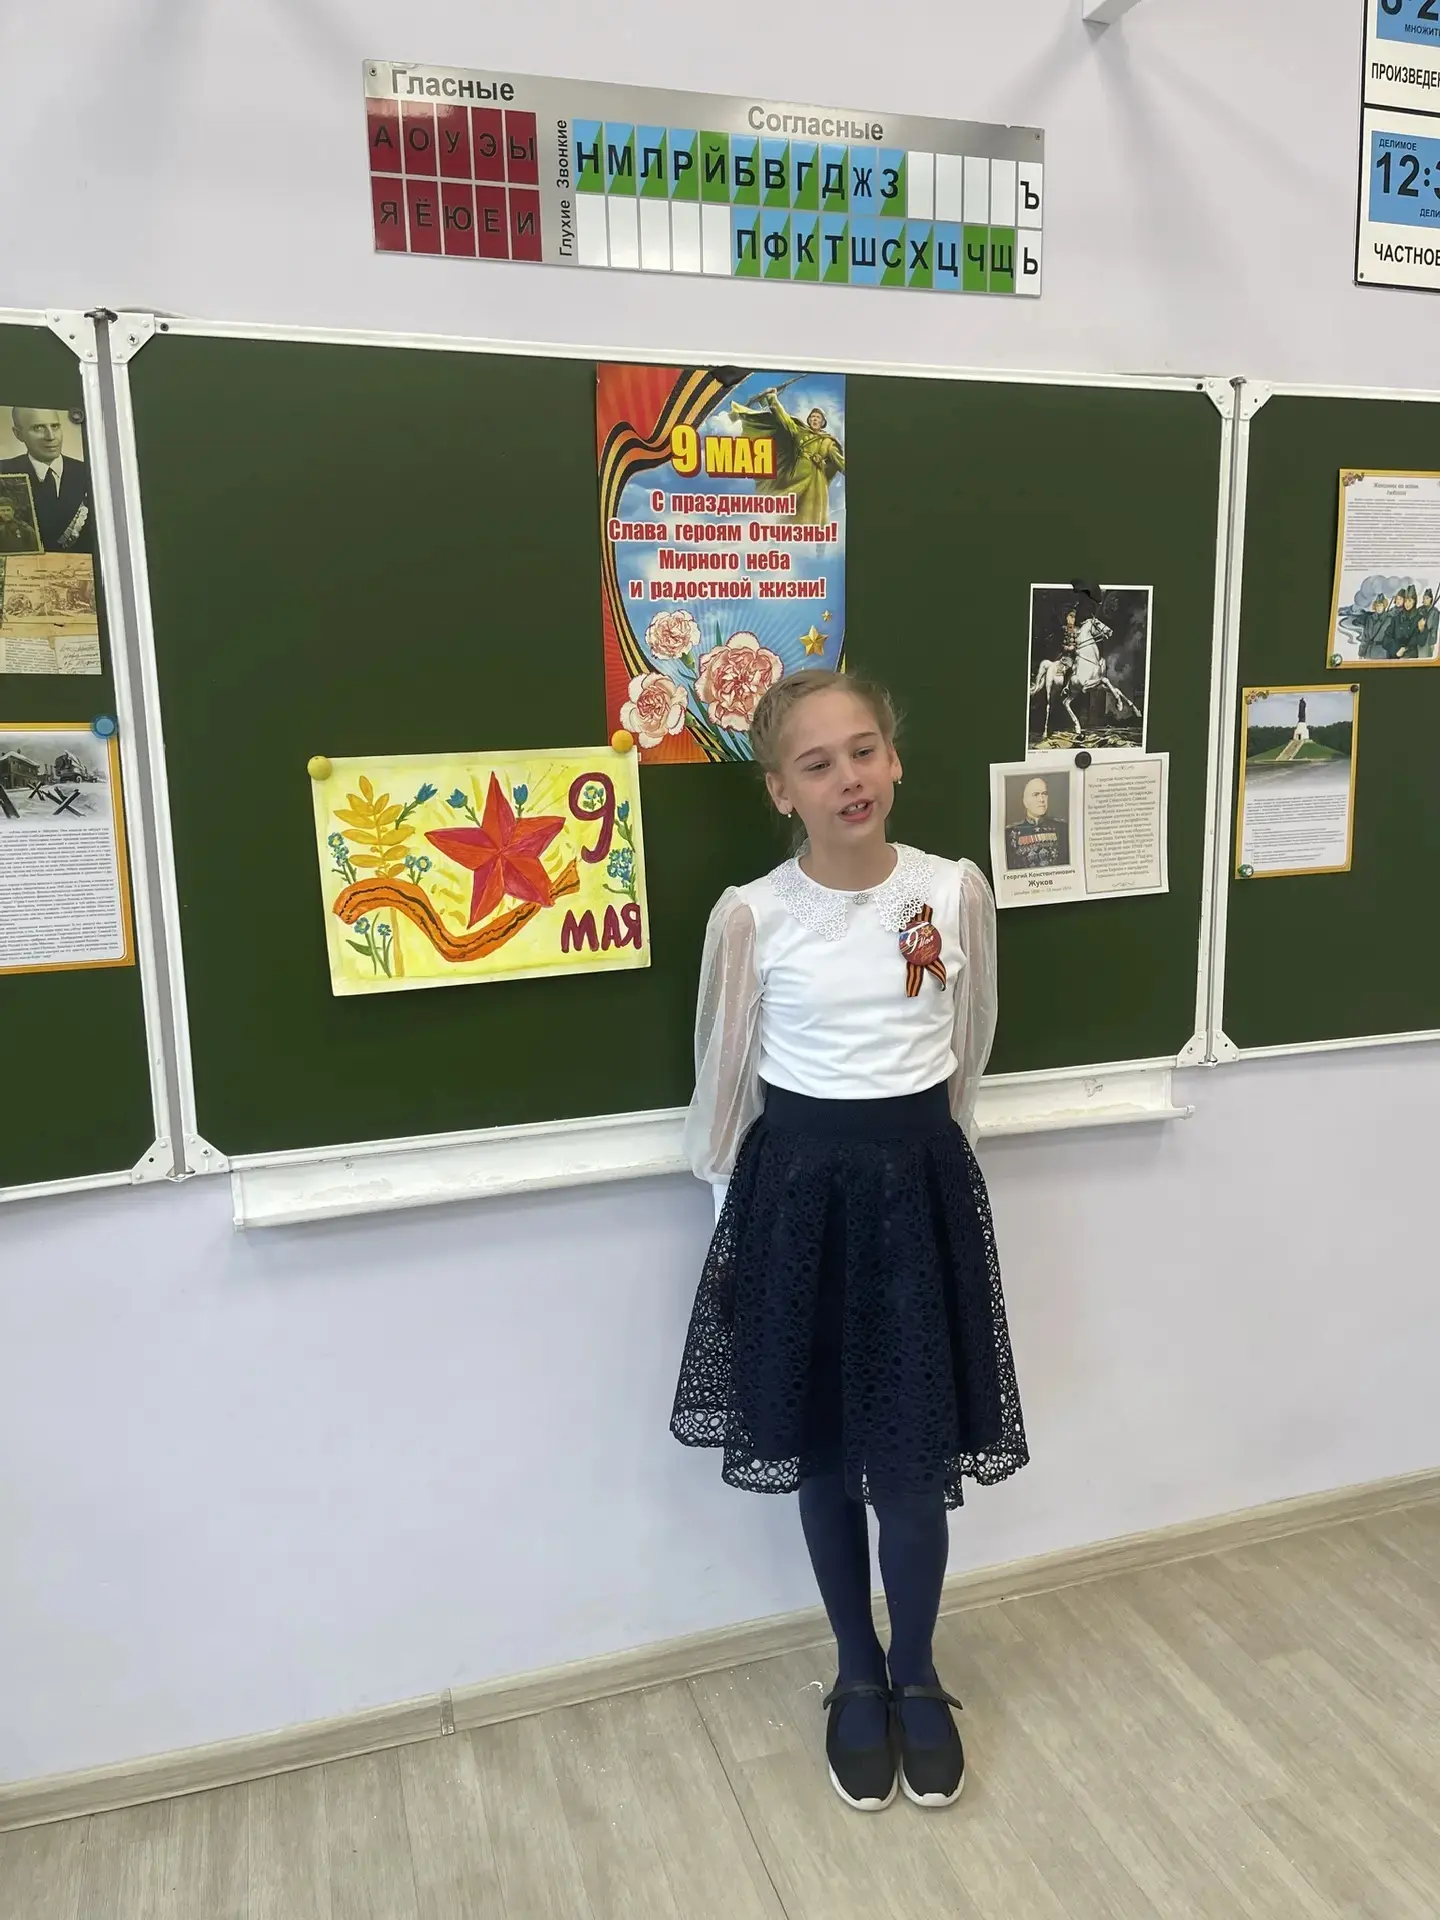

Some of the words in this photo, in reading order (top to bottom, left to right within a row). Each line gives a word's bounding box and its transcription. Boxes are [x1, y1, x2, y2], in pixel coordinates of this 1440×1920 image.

[1405, 24, 1440, 36] МНОЖИТ
[392, 69, 514, 101] Гласные
[748, 106, 883, 140] Согласные
[374, 125, 393, 148] А
[409, 128, 429, 150] О
[444, 130, 460, 153] У
[479, 133, 497, 157] Э
[510, 136, 534, 160] Ы
[557, 119, 570, 188] Звонкие
[1379, 139, 1416, 151] ДЕЛИМОЕ
[576, 142, 599, 174] Н
[607, 144, 633, 176] М
[640, 148, 663, 179] Л
[673, 150, 693, 180] Р
[705, 146, 725, 184] Й
[735, 156, 755, 186] Б
[765, 159, 785, 189] В
[797, 162, 813, 191] Г
[822, 163, 845, 200] Д
[853, 167, 872, 197] Ж
[880, 169, 899, 198] З
[1020, 181, 1039, 209] Ъ
[380, 201, 398, 224] Я
[416, 199, 432, 227] Ё
[444, 206, 472, 231] Ю
[484, 208, 500, 232] Е
[517, 212, 534, 235] И
[559, 200, 575, 256] Глухие
[737, 229, 757, 259] П
[764, 232, 788, 261] Ф
[797, 233, 814, 263] К
[825, 235, 843, 264] Т
[852, 237, 876, 266] Ш
[882, 239, 901, 268] С
[909, 240, 928, 269] Х
[938, 242, 958, 277] Ц
[968, 244, 984, 272] Ч
[991, 244, 1013, 278] Щ
[1023, 247, 1038, 275] Ь
[671, 424, 698, 476] 9
[705, 437, 775, 477] МАЯ
[652, 491, 664, 512] С
[672, 494, 796, 515] праздником!
[608, 520, 667, 540] Слава
[675, 524, 741, 543] героям
[750, 522, 837, 542] Отчизны!
[659, 550, 739, 571] Мирного
[746, 552, 790, 570] неба
[630, 582, 642, 598] и
[651, 577, 751, 599] радостной
[759, 579, 826, 598] жизни!
[568, 772, 615, 864] 9
[1028, 879, 1054, 888] Жуков
[560, 902, 642, 953] МАЯ
